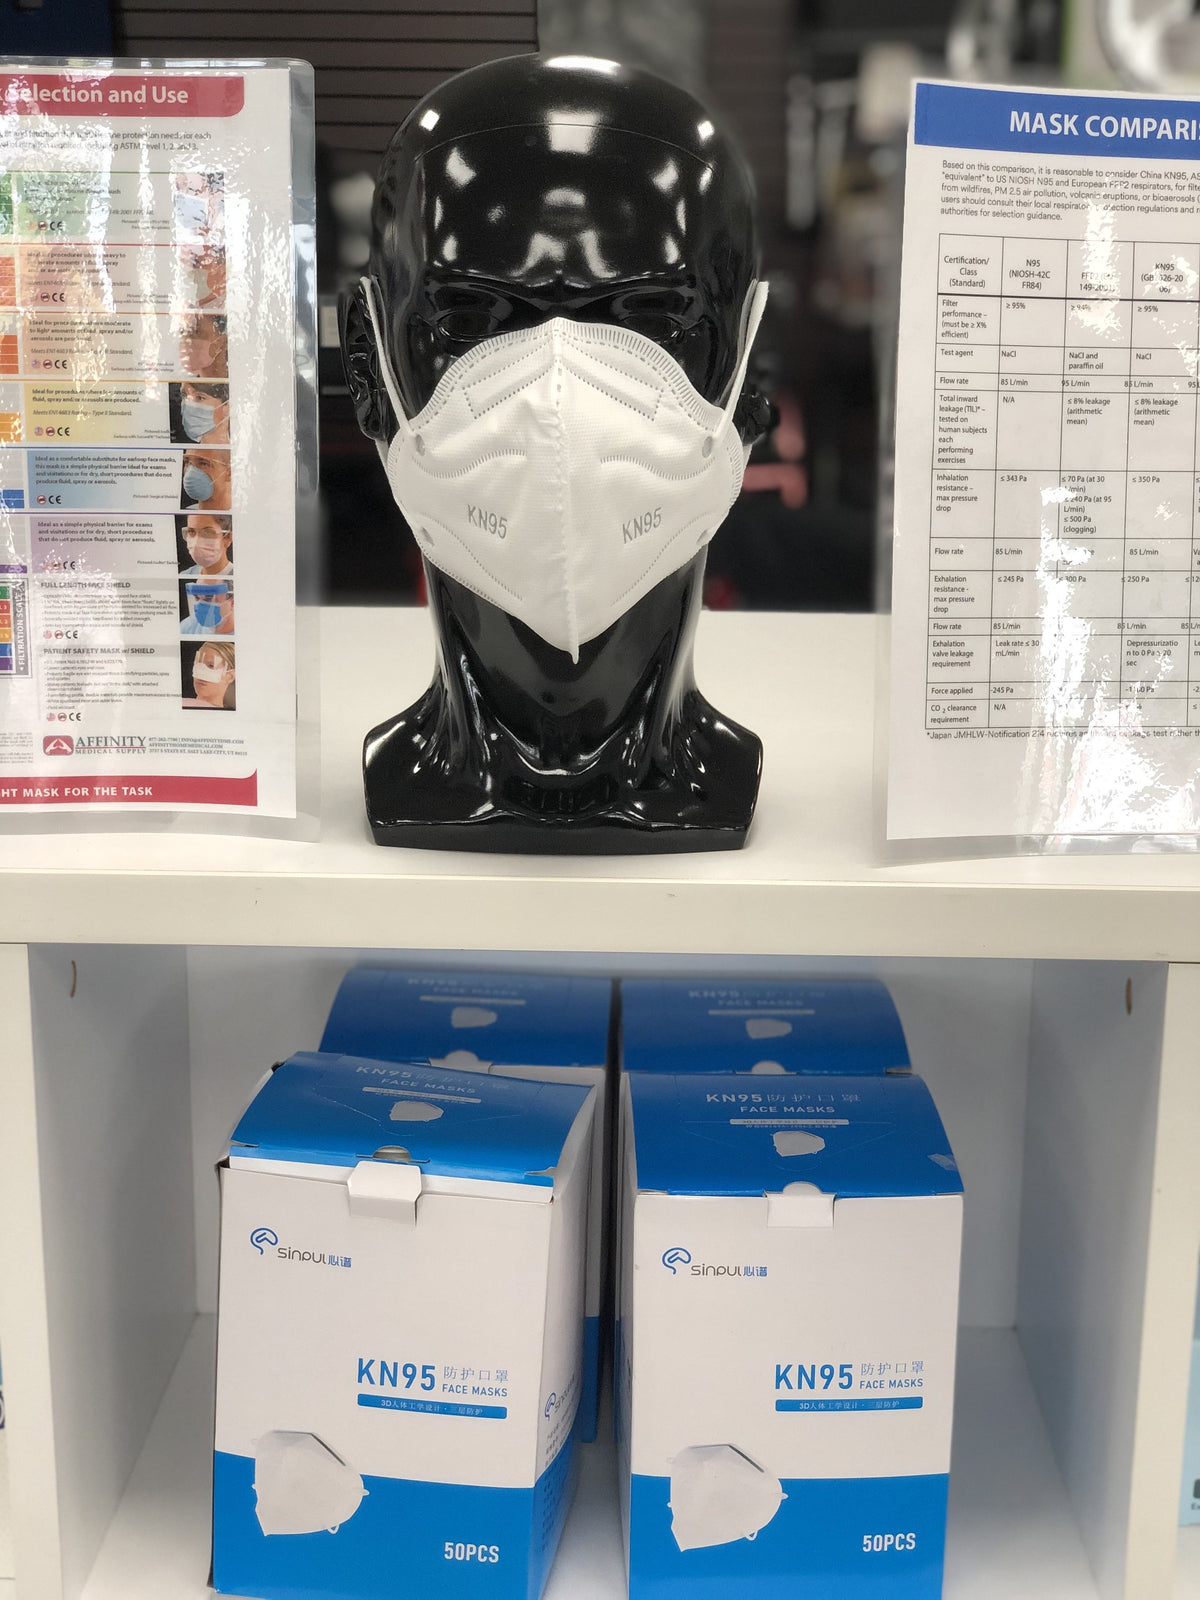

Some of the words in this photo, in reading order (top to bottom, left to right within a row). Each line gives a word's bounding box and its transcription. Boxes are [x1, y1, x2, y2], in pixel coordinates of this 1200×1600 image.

[8, 84, 103, 103] election
[108, 85, 146, 103] and
[153, 86, 188, 103] Use
[1010, 110, 1079, 136] MASK
[1084, 116, 1200, 141] COMPARI
[943, 160, 964, 170] Based
[977, 163, 989, 171] this
[992, 164, 1036, 174] comparison,
[1038, 166, 1043, 174] it
[1045, 167, 1050, 175] is
[1052, 168, 1093, 177] reasonable
[1140, 171, 1161, 179] China
[1164, 172, 1188, 181] KN95,
[996, 175, 1006, 183] US
[1009, 176, 1034, 184] NIOSH
[1037, 177, 1053, 186] N95
[1055, 179, 1069, 187] and
[1071, 179, 1107, 189] European
[1131, 183, 1173, 191] respirators,
[940, 207, 978, 216] authorities
[992, 210, 1024, 218] selection
[1027, 211, 1062, 221] guidance.
[944, 255, 989, 265] Certification/
[1026, 259, 1041, 267] N95
[960, 267, 977, 276] Class
[1155, 263, 1175, 271] KN95
[949, 278, 985, 288] (Standard)
[1022, 281, 1041, 290] FR84)
[942, 331, 968, 339] efficient)
[955, 349, 973, 357] agent
[1067, 407, 1102, 415] (arithmetic
[1134, 408, 1170, 416] (arithmetic
[939, 415, 958, 423] tested
[1134, 418, 1154, 426] mean)
[938, 446, 973, 455] performing
[467, 504, 508, 539] KN95
[622, 507, 662, 544] KN95
[1063, 526, 1096, 534] (clogging)
[932, 660, 970, 668] requirement
[950, 687, 973, 695] applied
[931, 716, 969, 724] requirement
[954, 730, 1029, 739] JMHLW-Notification
[76, 736, 147, 747] AFFINITY
[23, 787, 60, 798] MASK
[64, 787, 89, 797] FOR
[94, 786, 117, 796] THE
[122, 786, 153, 796] TASK
[356, 1066, 412, 1078] KN95
[381, 1078, 418, 1086] FACE
[424, 1083, 476, 1094] MASKS
[706, 1094, 762, 1103] KN95
[357, 1358, 436, 1391] KN95
[443, 1366, 509, 1383] 防护口罩
[775, 1364, 853, 1390] KN95
[861, 1361, 924, 1376] 防护口罩
[859, 1380, 885, 1389] FACE
[889, 1378, 923, 1388] MASKS
[442, 1384, 468, 1394] FACE
[472, 1386, 508, 1397] MASKS
[862, 1533, 916, 1552] 50PCS
[444, 1542, 500, 1563] 50PCS
